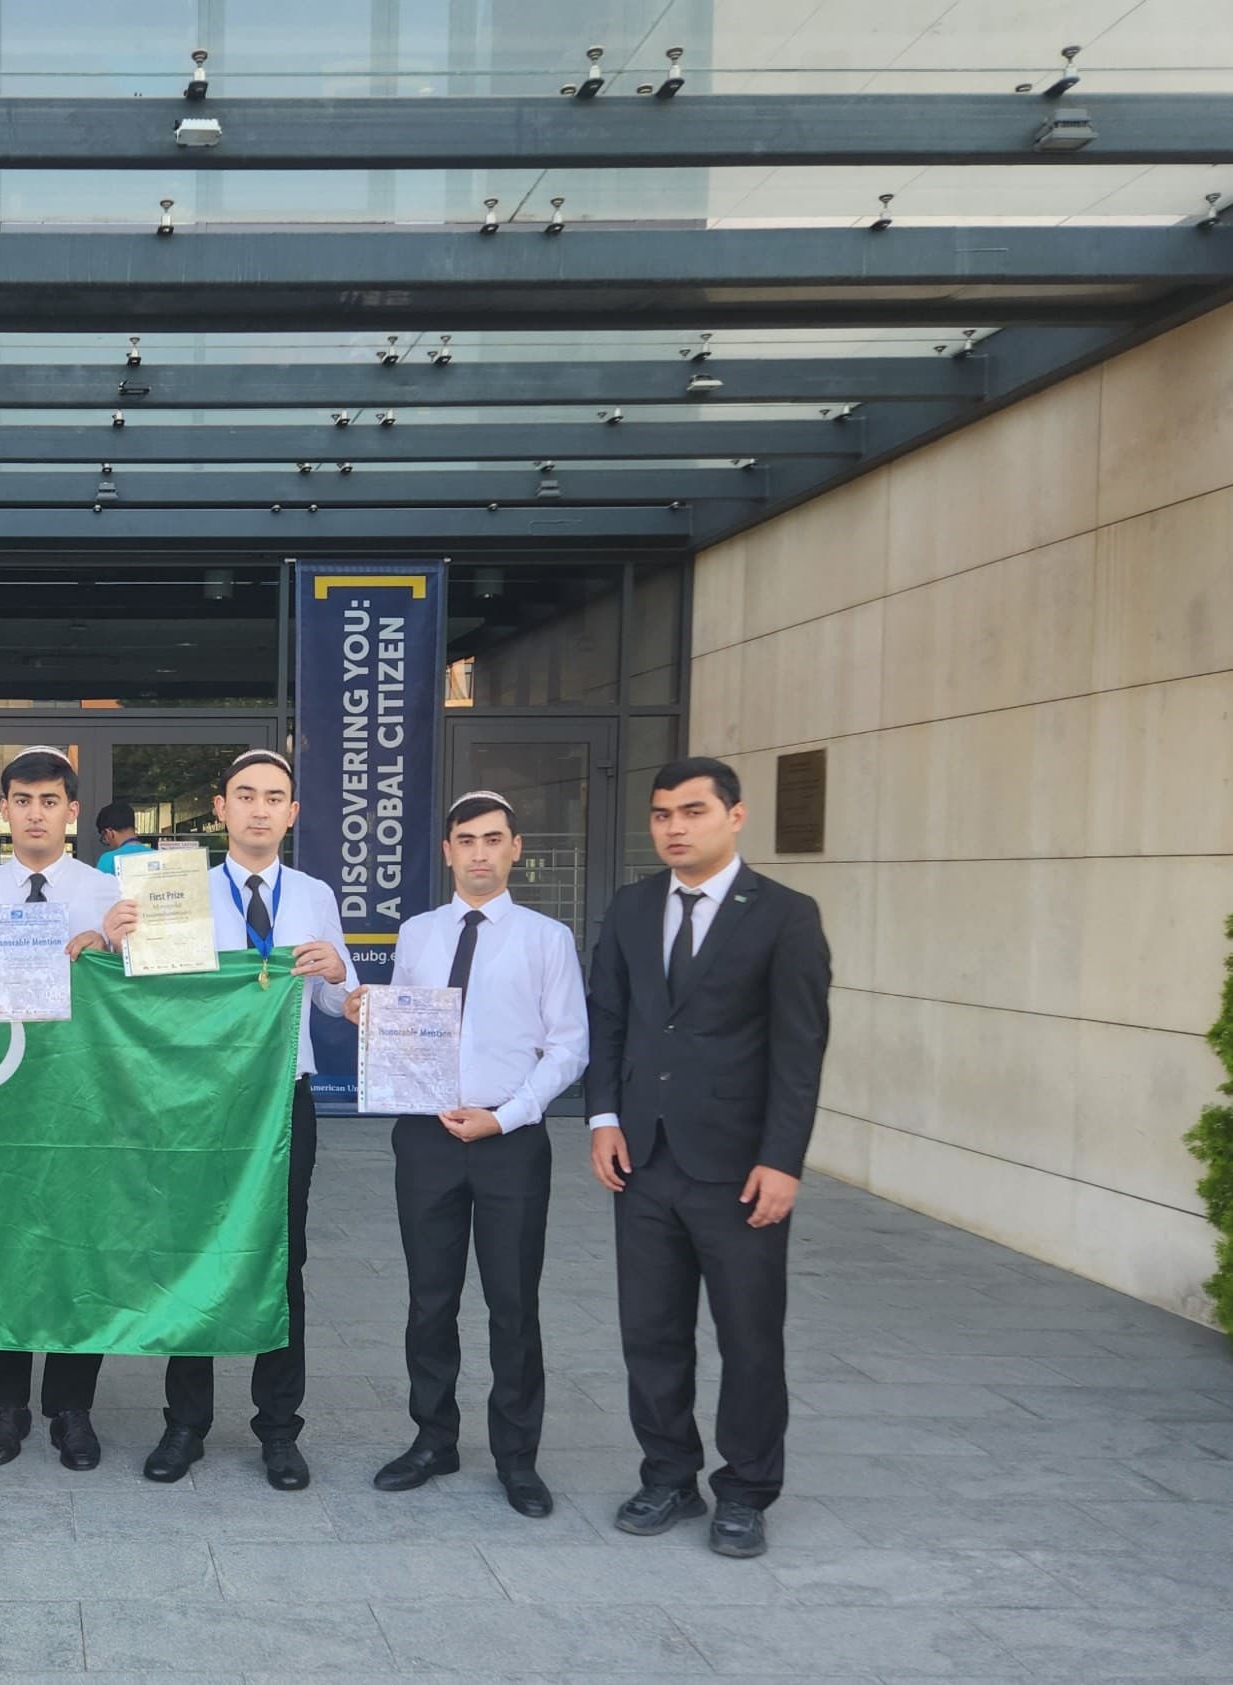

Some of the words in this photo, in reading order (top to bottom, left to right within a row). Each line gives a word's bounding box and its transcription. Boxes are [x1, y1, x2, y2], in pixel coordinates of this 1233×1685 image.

[343, 600, 370, 682] YOU:
[377, 617, 405, 749] CITIZEN
[341, 689, 369, 918] DISCOVERING
[376, 756, 404, 889] GLOBAL
[149, 892, 166, 901] First
[167, 891, 184, 900] Prize
[376, 897, 401, 919] A
